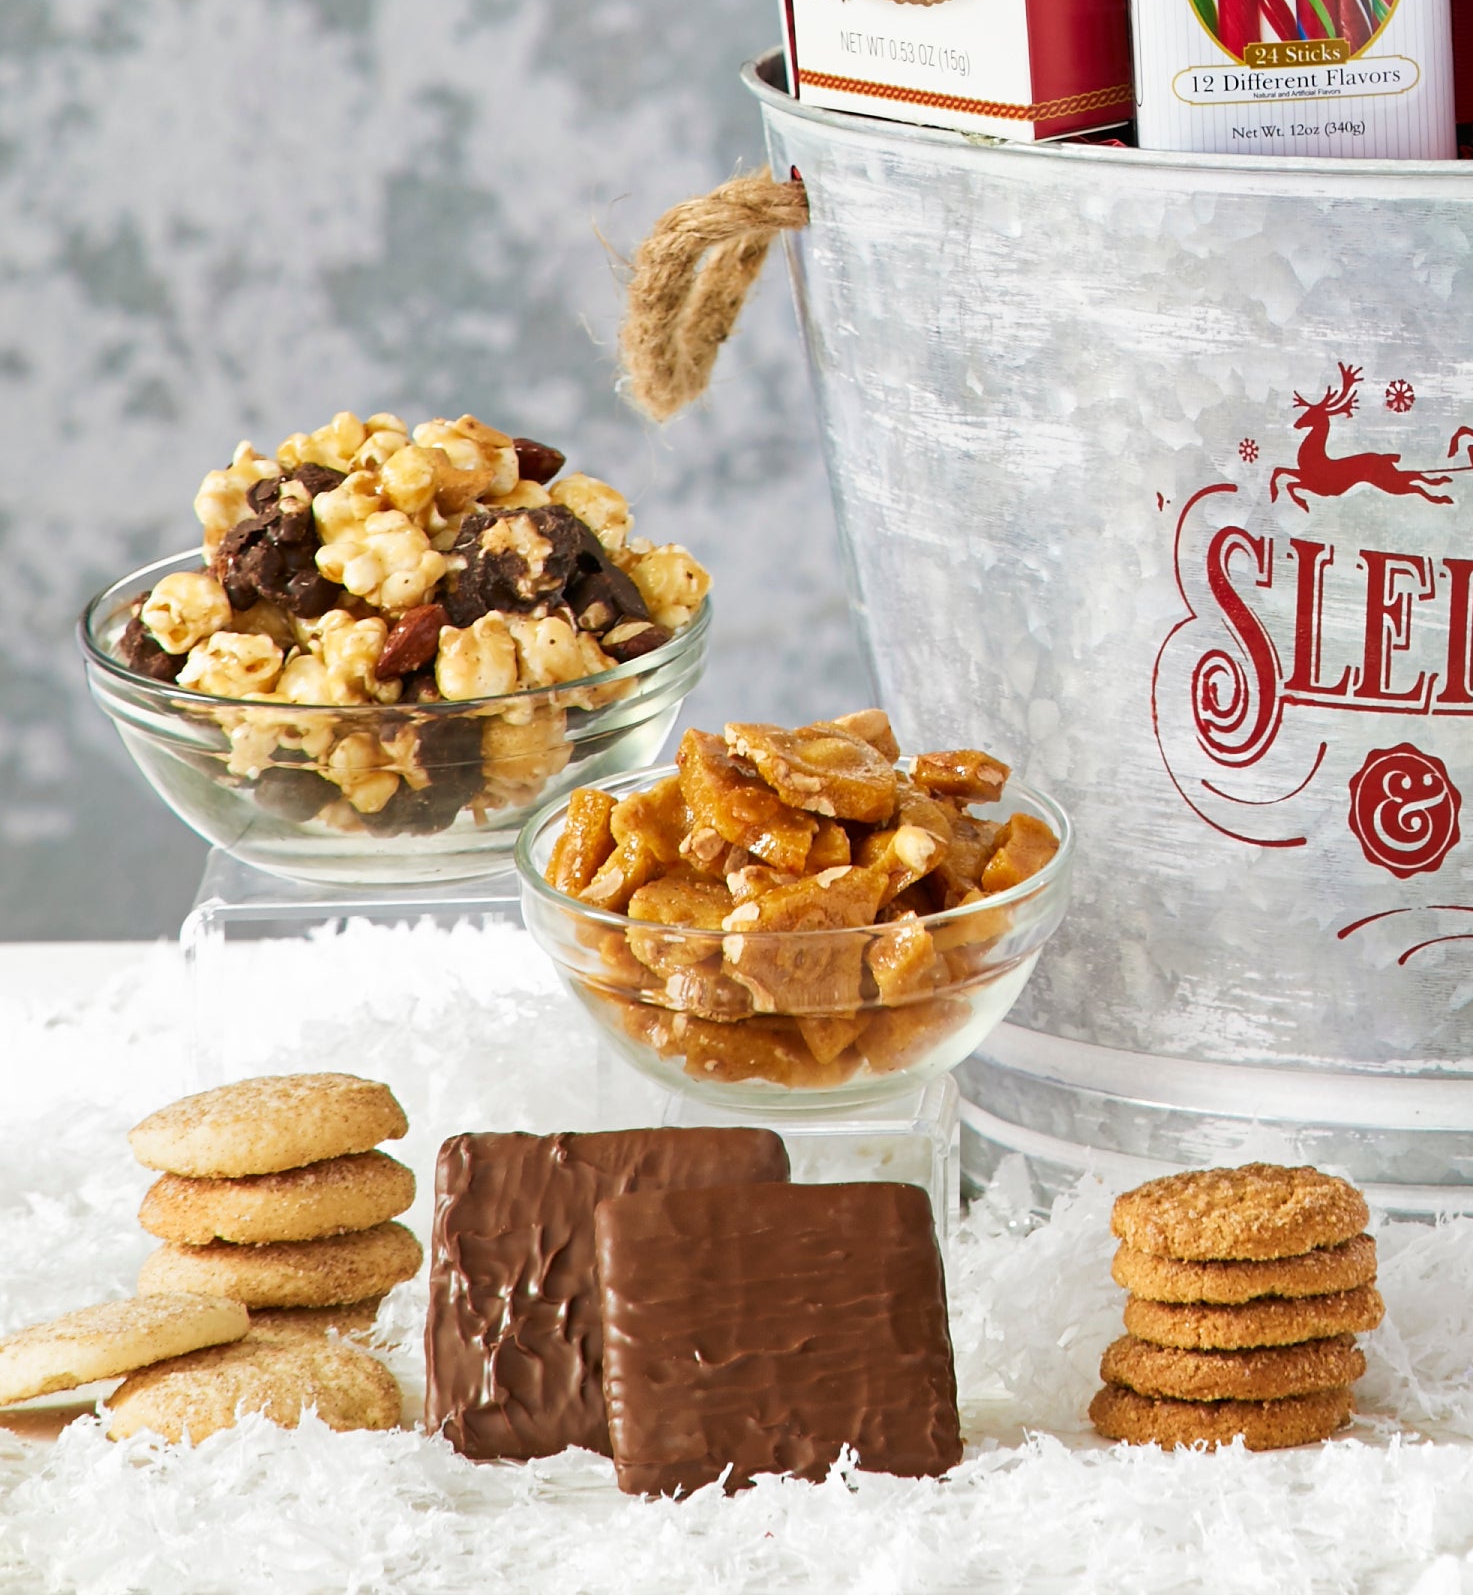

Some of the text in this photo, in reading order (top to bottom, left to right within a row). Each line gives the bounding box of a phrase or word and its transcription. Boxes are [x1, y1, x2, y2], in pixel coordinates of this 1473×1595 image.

[840, 30, 970, 76] NET WT 0.53 OZ (15g)
[1255, 43, 1342, 65] 24 Sticks
[1191, 68, 1401, 93] 12 Different Flavors
[1253, 88, 1341, 99] Natural and Artificial Flavors
[1232, 120, 1366, 139] Net Wt. 12oz (340g)
